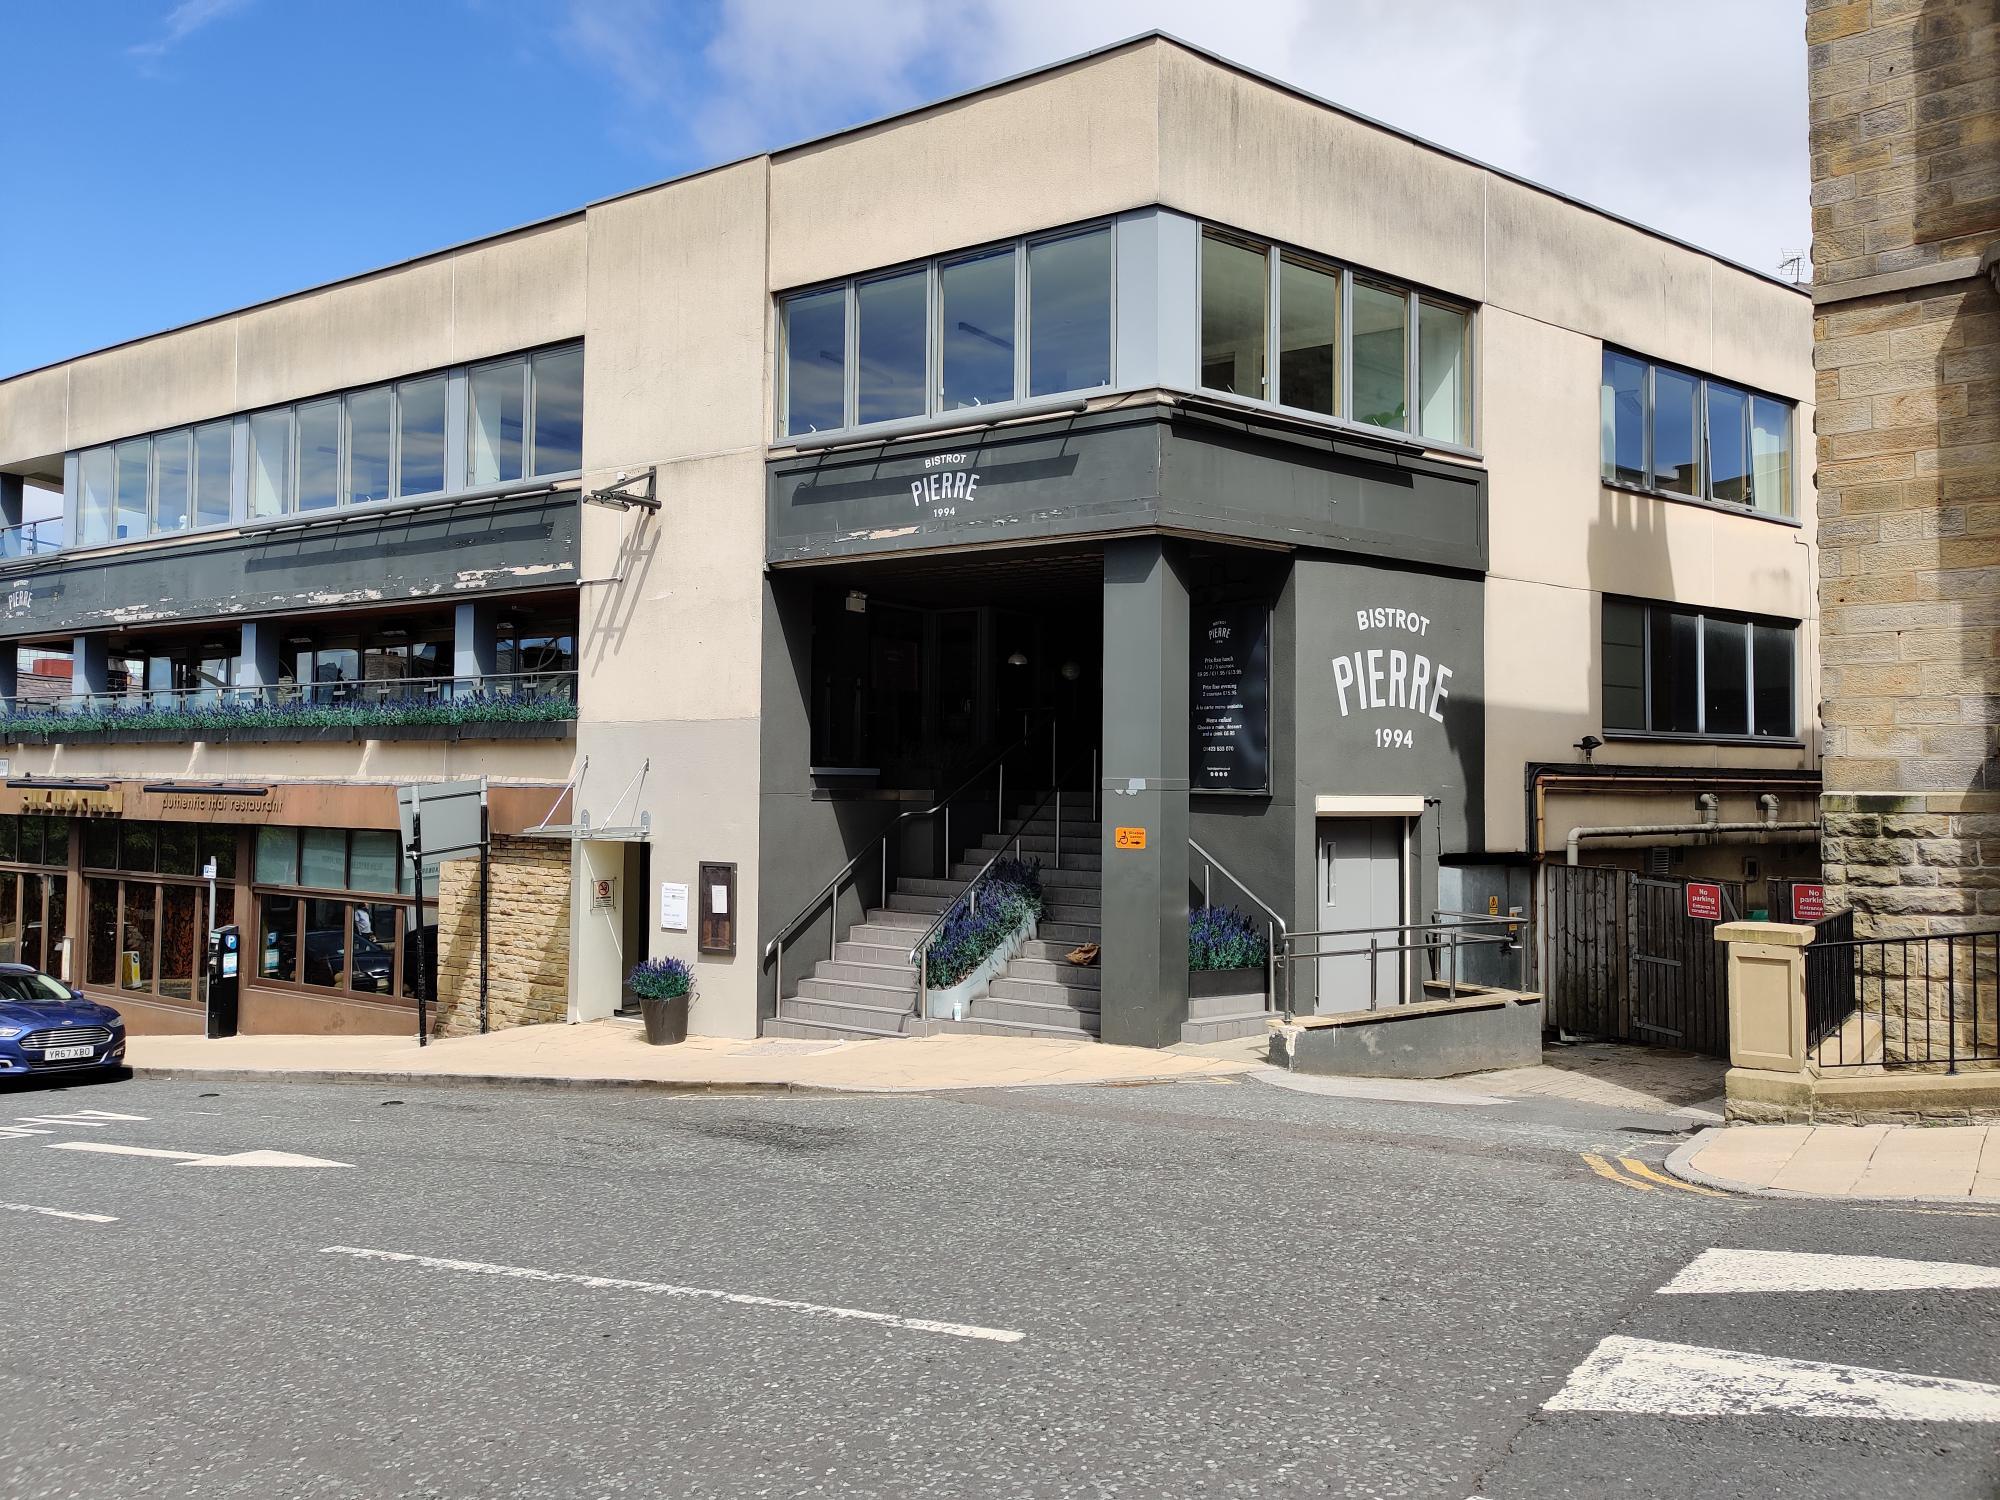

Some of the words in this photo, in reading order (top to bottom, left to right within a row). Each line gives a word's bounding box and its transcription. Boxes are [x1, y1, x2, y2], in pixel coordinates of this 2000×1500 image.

[925, 454, 966, 468] BISTROT
[911, 471, 980, 506] PIERRE
[934, 507, 955, 517] 1994
[9, 591, 32, 610] PIERRE
[1357, 608, 1430, 637] BISTROT
[1209, 627, 1231, 640] PIERRE
[1332, 649, 1453, 723] PIERRE
[1375, 728, 1413, 748] 1994
[162, 795, 205, 809] authentic
[209, 795, 227, 811] thai
[230, 798, 283, 813] restaurant
[1692, 895, 1715, 905] parking
[1808, 889, 1820, 897] No
[49, 1050, 71, 1059] YR67
